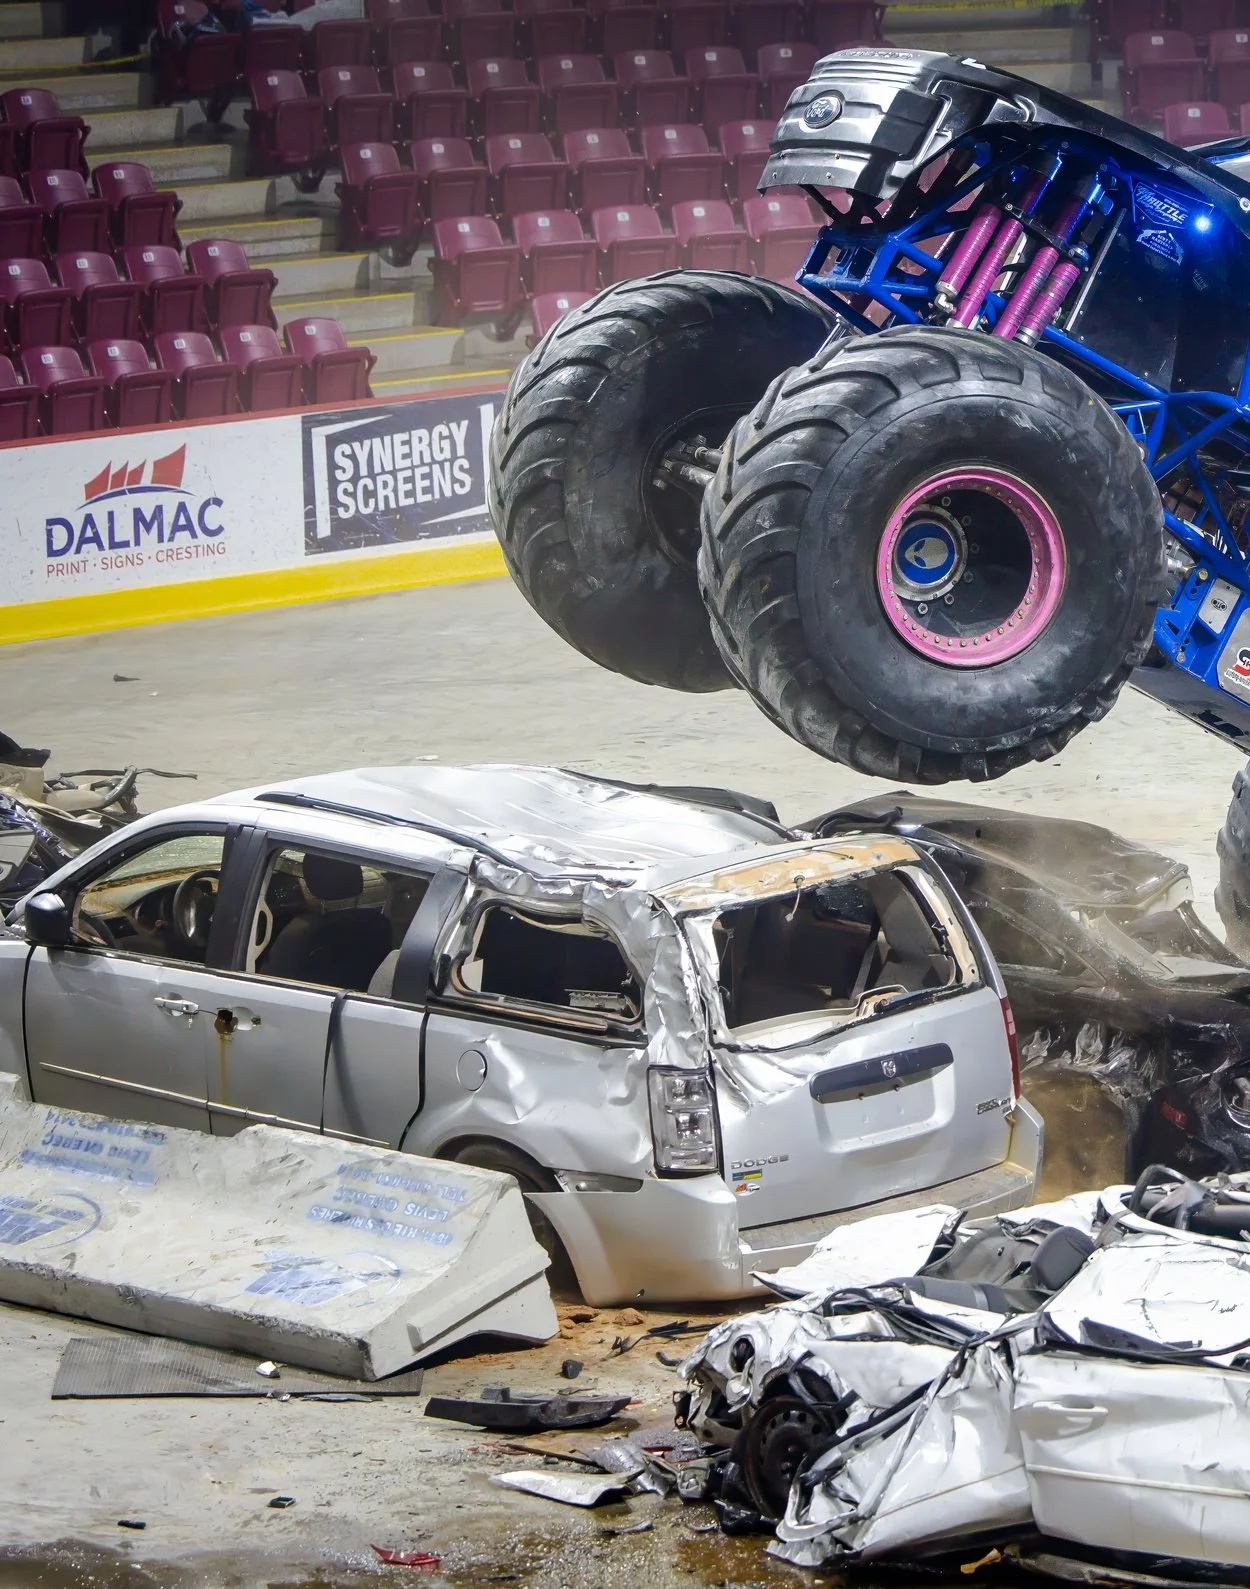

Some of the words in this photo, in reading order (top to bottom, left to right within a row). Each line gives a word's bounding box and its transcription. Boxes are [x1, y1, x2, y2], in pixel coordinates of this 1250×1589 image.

[806, 99, 829, 118] Ford
[333, 420, 469, 482] SYNERGY
[336, 457, 472, 519] SCREENS
[46, 497, 225, 558] DALMAC
[46, 558, 87, 578] PRINT
[100, 552, 144, 570] SIGNS
[155, 542, 226, 564] CRESTING
[731, 1154, 789, 1169] DODGE
